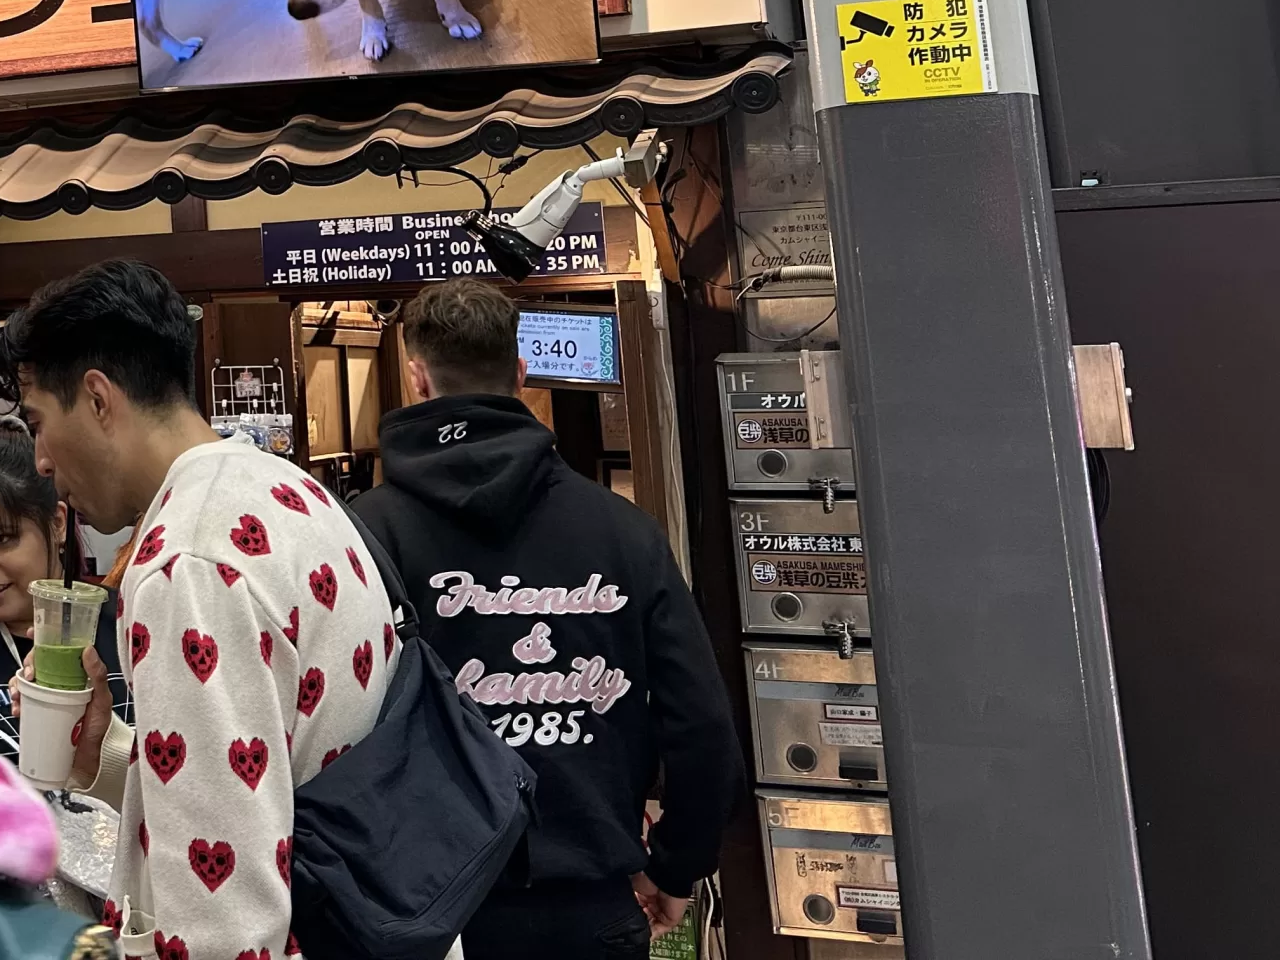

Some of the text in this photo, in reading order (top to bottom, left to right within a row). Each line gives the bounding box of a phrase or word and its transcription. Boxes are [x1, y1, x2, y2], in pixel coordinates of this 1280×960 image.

[907, 21, 968, 43] カメラ
[908, 44, 972, 66] 作動中
[923, 67, 960, 79] CCTV
[319, 217, 393, 236] 営業時間
[402, 214, 466, 230] Busine
[415, 230, 450, 240] OPEN
[780, 235, 830, 245] カムシャイニ
[286, 249, 317, 265] 平日
[321, 244, 410, 264] (Weekdays)
[570, 235, 597, 250] PM
[798, 248, 832, 266] Shin
[272, 268, 319, 285] 土日祝
[322, 264, 392, 283] (Holiday)
[572, 255, 599, 270] PM
[531, 340, 577, 359] 3:40
[727, 371, 756, 391] 1F
[762, 418, 801, 427] ASAKUSA
[763, 427, 809, 444] 浅草の
[740, 511, 770, 531] 3F
[745, 535, 846, 552] オウル株式会社
[777, 560, 818, 570] ASAKUSA
[429, 570, 629, 617] Friends
[512, 621, 557, 664] &
